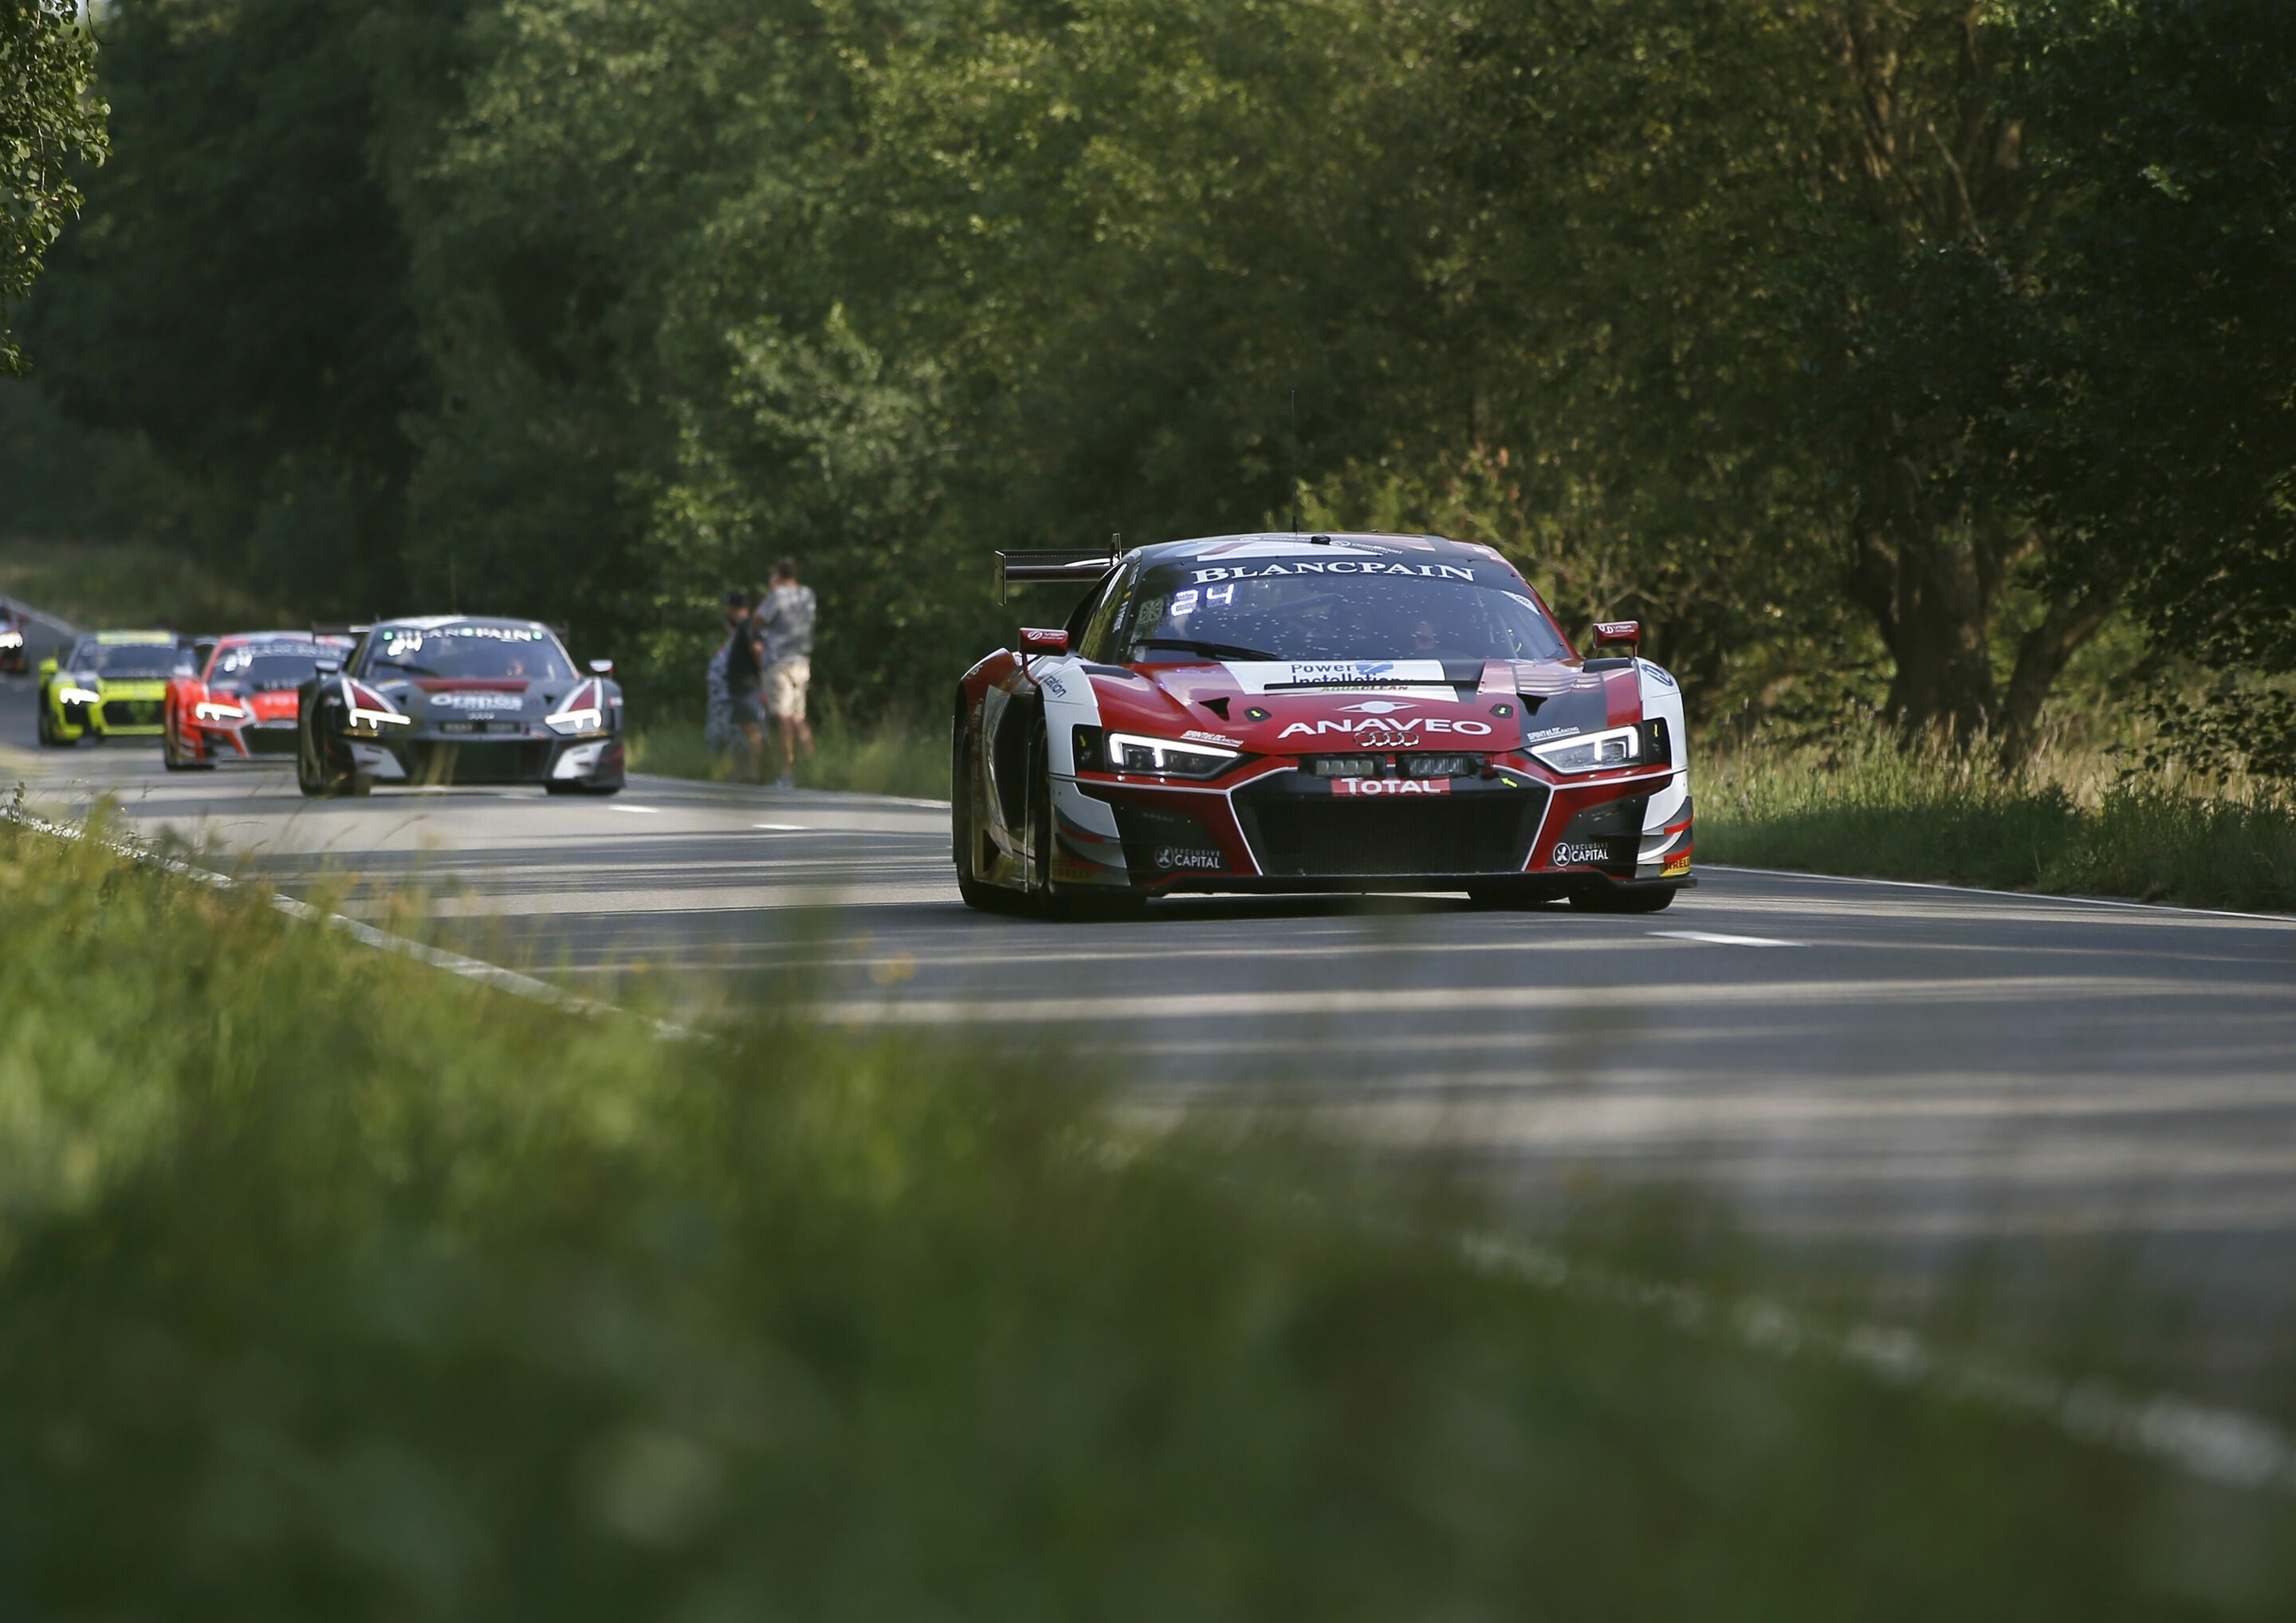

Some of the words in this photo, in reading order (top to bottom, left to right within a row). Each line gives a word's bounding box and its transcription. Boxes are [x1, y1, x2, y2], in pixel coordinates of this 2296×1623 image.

[1190, 561, 1475, 583] BLANCPAIN
[1170, 583, 1236, 617] 24
[1291, 663, 1355, 674] Power
[1277, 718, 1492, 738] ANAVEO
[1341, 777, 1441, 795] TOTAL
[1174, 847, 1221, 857] EXCLUSIVE
[1571, 849, 1609, 863] CAPITAL
[1174, 854, 1221, 868] CAPITAL
